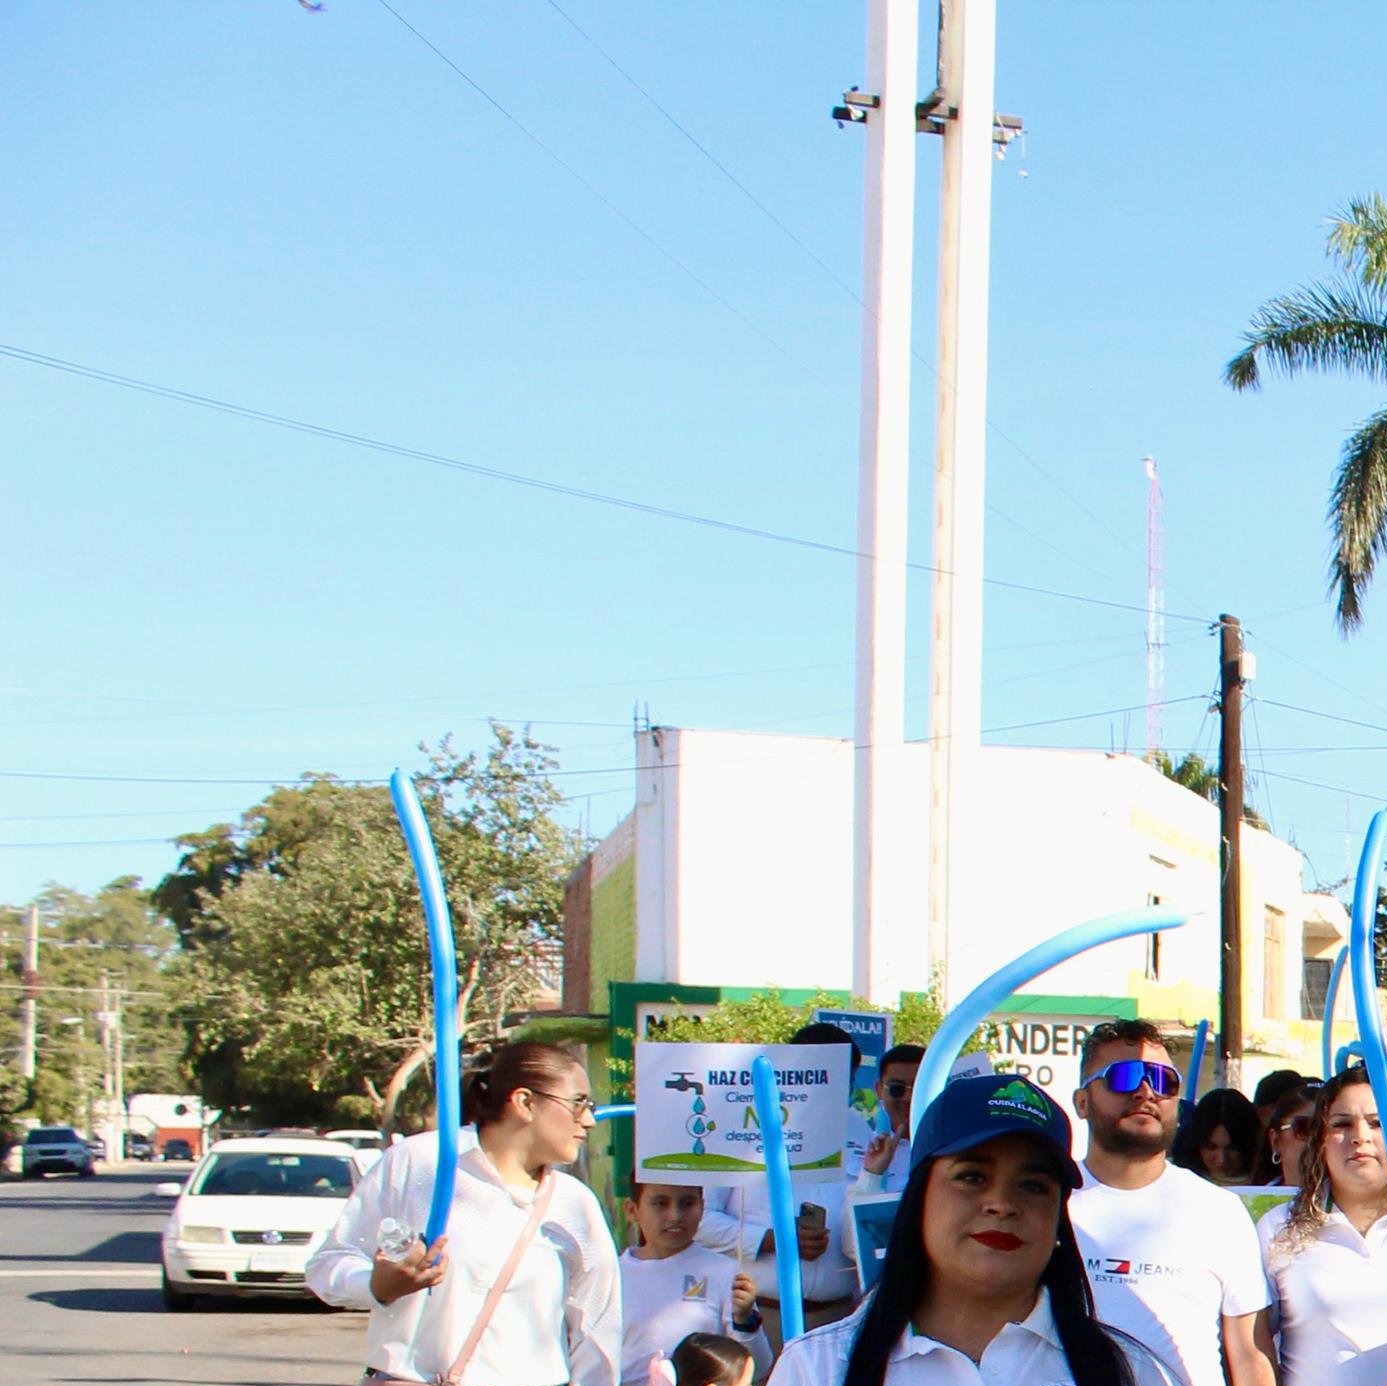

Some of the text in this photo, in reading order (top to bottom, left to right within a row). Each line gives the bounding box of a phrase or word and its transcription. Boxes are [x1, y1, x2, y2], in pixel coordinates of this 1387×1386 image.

[708, 1070, 829, 1086] HAZ CCIENCIA
[725, 1090, 755, 1103] Cierr
[1134, 1263, 1185, 1276] JEANS
